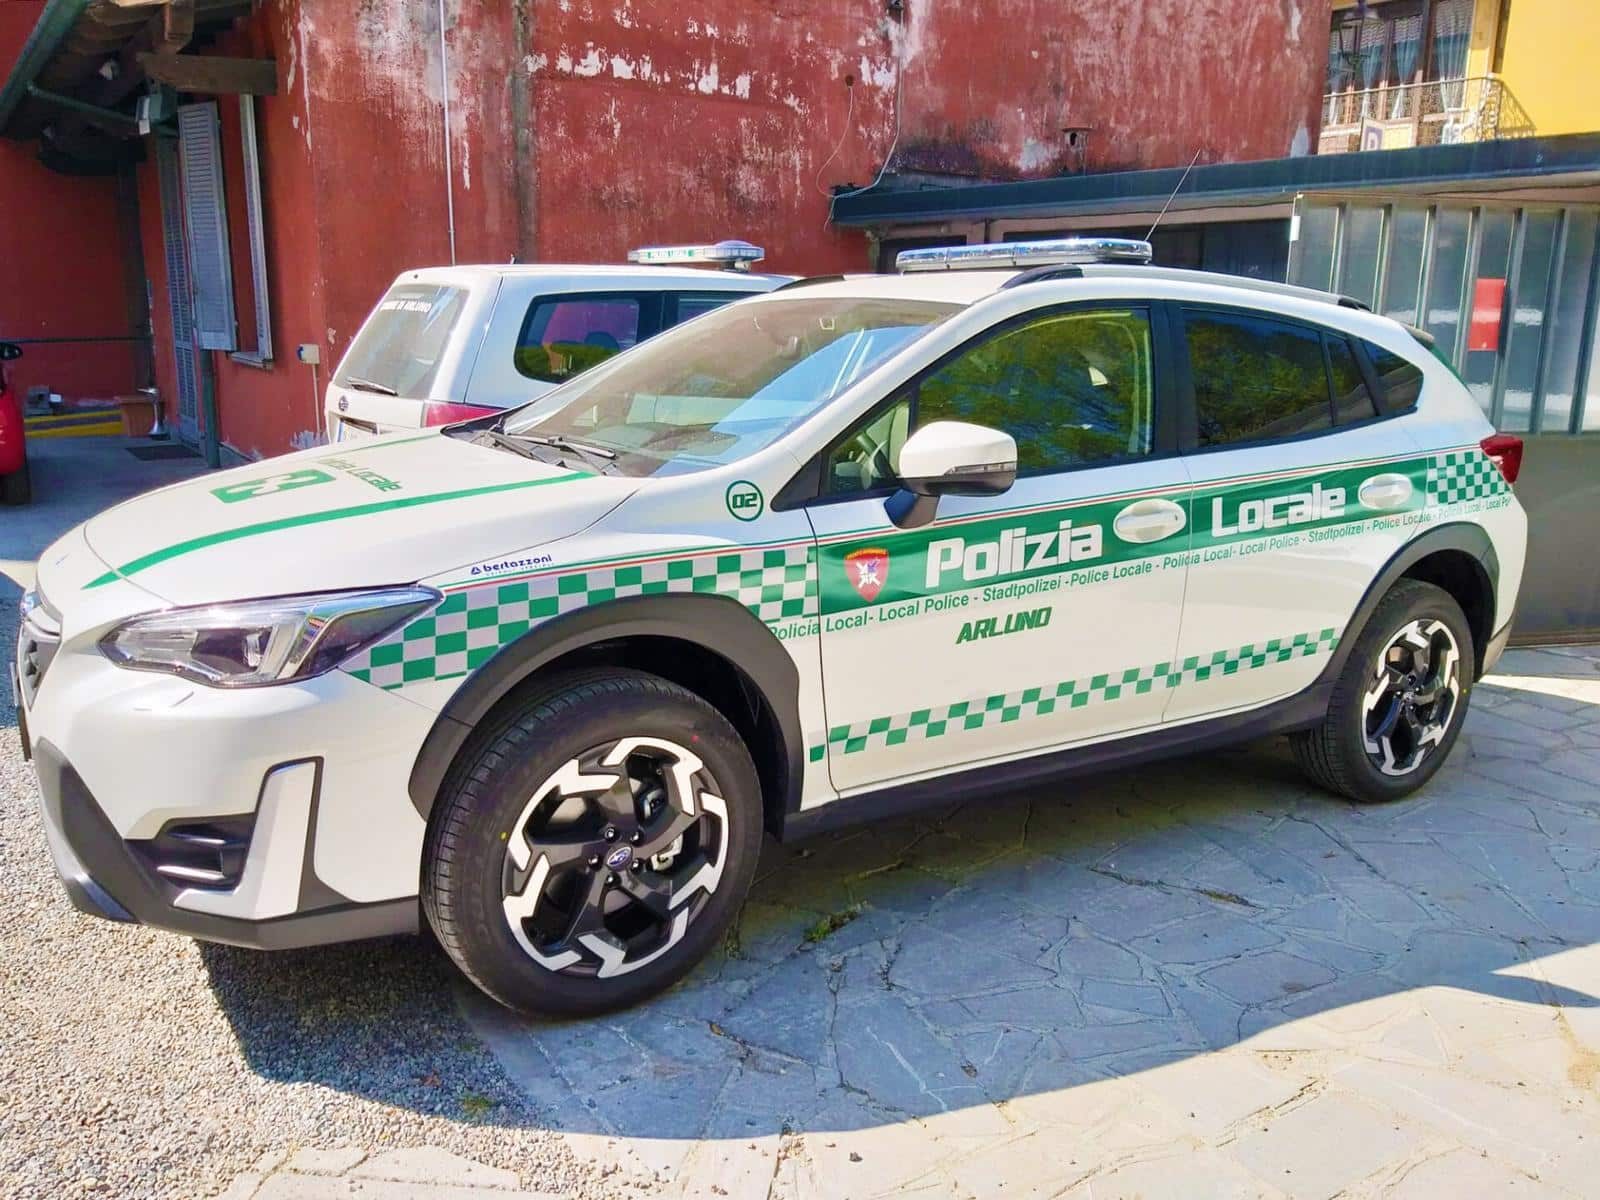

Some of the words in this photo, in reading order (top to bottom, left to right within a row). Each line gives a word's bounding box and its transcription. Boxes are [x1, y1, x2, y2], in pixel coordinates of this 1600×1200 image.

[732, 492, 758, 509] 02
[925, 519, 1103, 589] Polizia
[1211, 482, 1346, 538] Locale
[483, 554, 552, 572] bertazzoni
[879, 600, 920, 622] Local
[924, 593, 969, 613] Police
[982, 576, 1061, 602] Stadtpolizei
[1112, 561, 1152, 579] Locale
[1162, 551, 1200, 569] Policia
[1239, 540, 1266, 555] Local
[1269, 535, 1299, 550] Police
[1308, 523, 1364, 542] Stadtpolizei
[1372, 517, 1400, 531] Police
[1402, 511, 1431, 527] Locale
[956, 606, 1053, 645] ARLUNO
